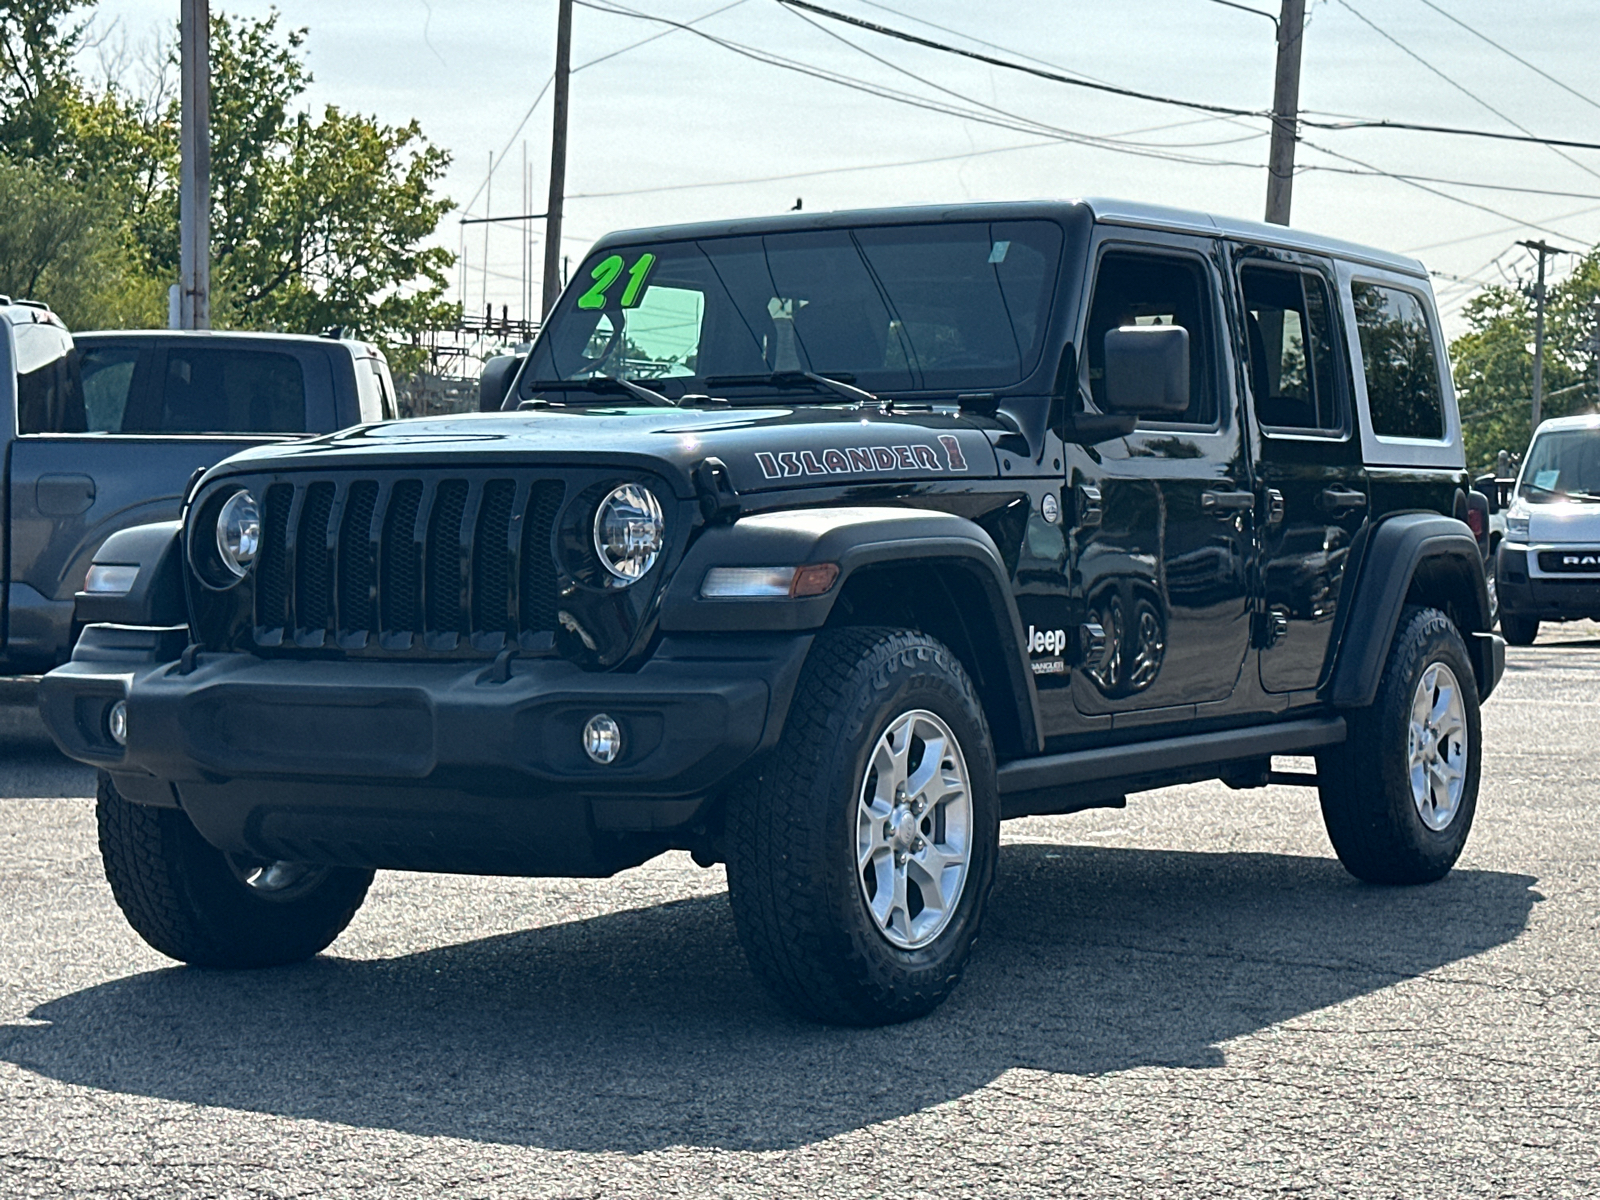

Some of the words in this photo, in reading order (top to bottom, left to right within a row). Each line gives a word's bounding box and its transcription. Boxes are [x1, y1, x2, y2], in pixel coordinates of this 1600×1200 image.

[578, 253, 656, 309] 21
[755, 444, 944, 479] ISLANDER
[1563, 556, 1600, 564] RA
[1027, 625, 1066, 656] Jeep
